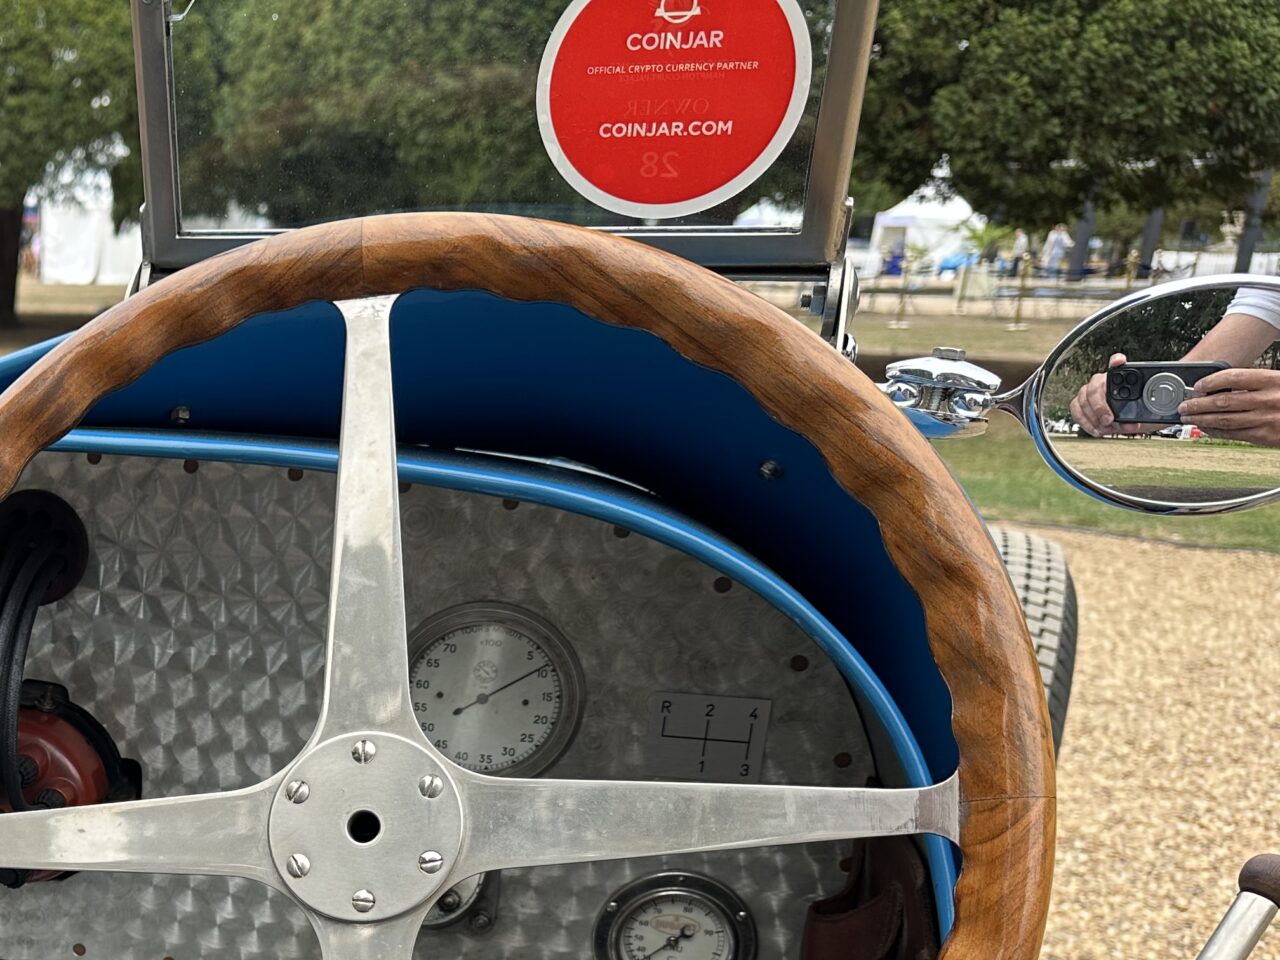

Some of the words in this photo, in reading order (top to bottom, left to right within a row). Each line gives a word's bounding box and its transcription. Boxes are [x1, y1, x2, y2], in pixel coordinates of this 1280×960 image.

[626, 30, 724, 51] COINJAR
[587, 64, 626, 75] OFFICIAL
[628, 63, 663, 74] CRYPTO
[666, 62, 714, 73] CURRENCY
[717, 61, 759, 71] PARTNER
[599, 120, 733, 139] COINJAR.COM
[443, 643, 457, 654] 70
[526, 650, 535, 661] 5
[426, 658, 440, 669] 65
[415, 679, 430, 690] 60
[541, 691, 553, 702] 15
[413, 702, 428, 713] 55
[661, 700, 673, 714] R
[705, 703, 716, 718] 2
[749, 707, 759, 720] 4
[533, 714, 548, 725] 20
[421, 722, 435, 733] 50
[520, 733, 535, 744] 25
[434, 739, 448, 750] 45
[454, 751, 469, 762] 40
[500, 746, 516, 757] 30
[478, 753, 493, 764] 35
[698, 760, 705, 774] 1
[739, 763, 750, 777] 3
